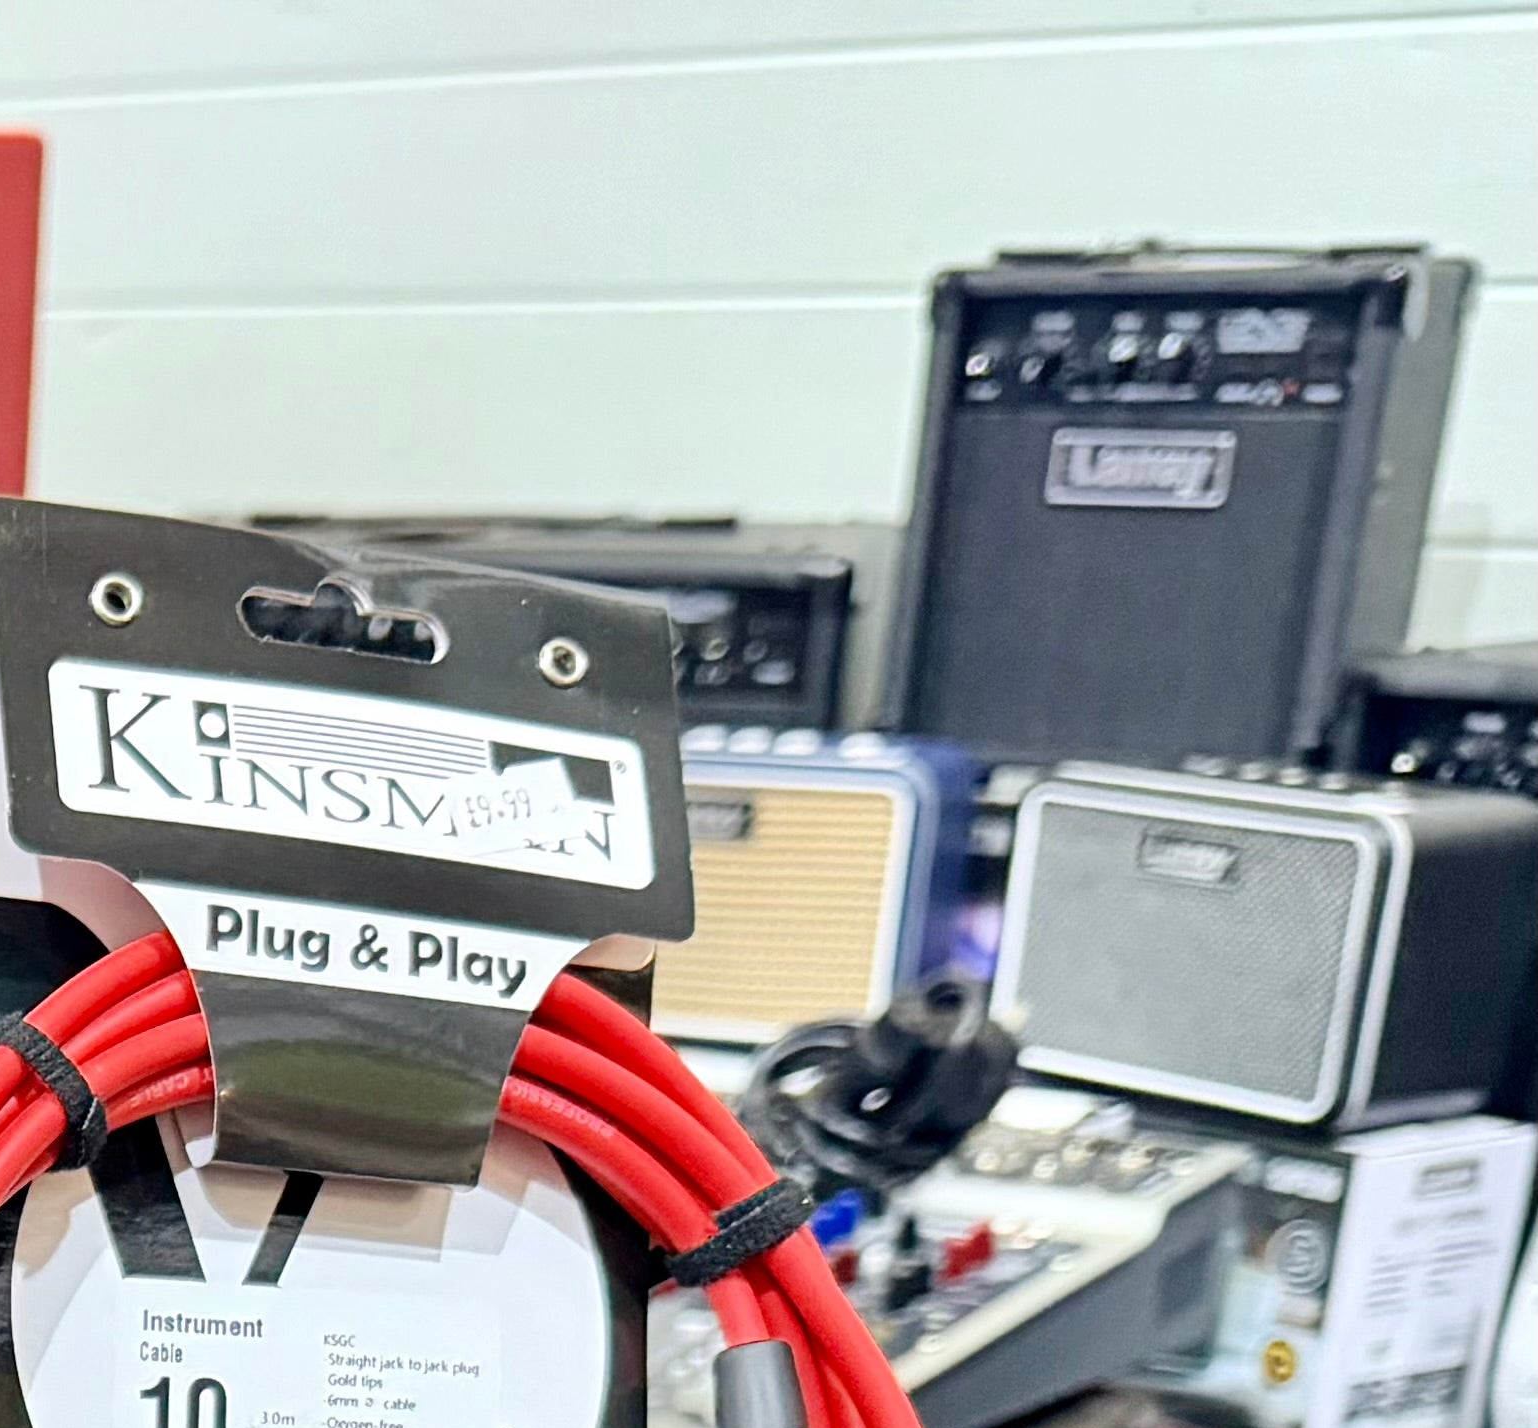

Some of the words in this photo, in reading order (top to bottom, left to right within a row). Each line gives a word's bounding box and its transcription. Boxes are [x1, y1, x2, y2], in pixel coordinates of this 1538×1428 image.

[465, 788, 531, 828] £9.99
[206, 904, 331, 973] Plug
[350, 924, 389, 973] &
[408, 930, 527, 999] Play
[142, 1309, 264, 1338] Instrument
[139, 1341, 183, 1363] Cable
[323, 1333, 356, 1348] KSGC
[379, 1354, 404, 1373] jack
[408, 1358, 422, 1372] to
[423, 1358, 448, 1375] jack
[453, 1361, 480, 1378] plug
[328, 1373, 357, 1387] Gold
[361, 1374, 383, 1391] tips
[383, 1397, 416, 1411] cable
